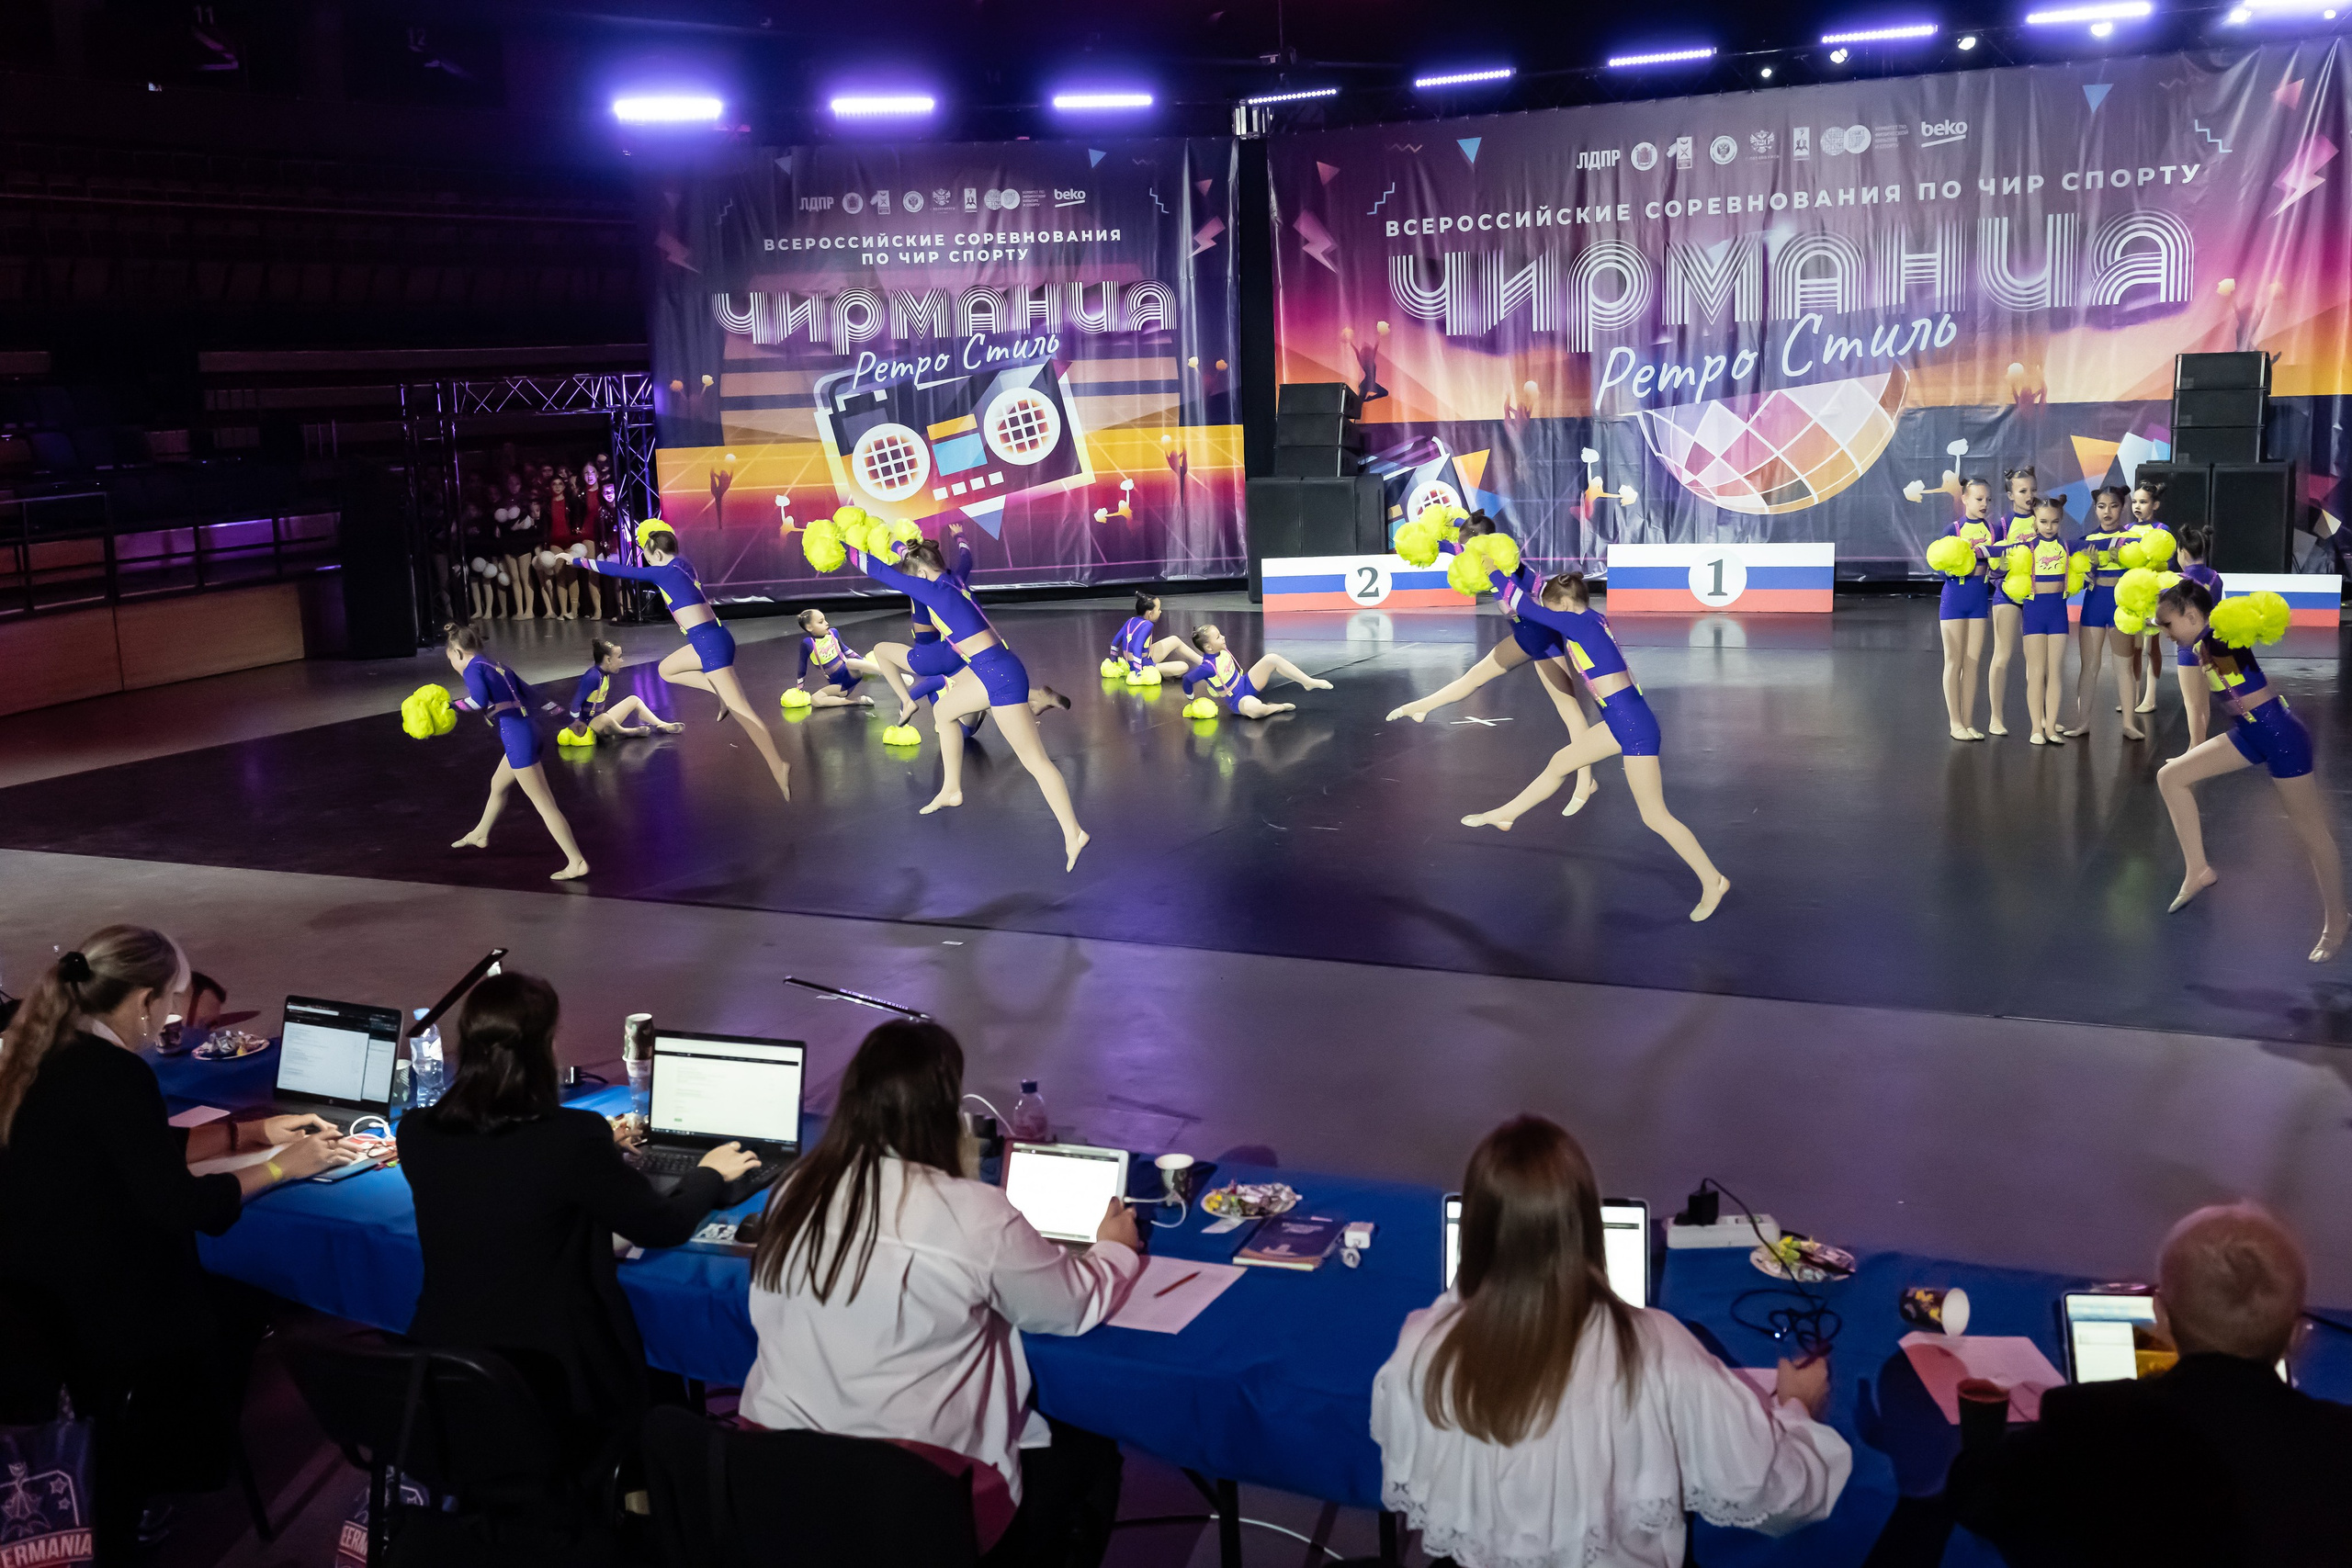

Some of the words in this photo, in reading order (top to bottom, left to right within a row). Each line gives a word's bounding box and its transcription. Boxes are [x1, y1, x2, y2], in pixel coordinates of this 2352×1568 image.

[1920, 118, 1968, 137] beko
[1576, 149, 1621, 172] ЛДПР
[799, 196, 834, 212] ЛДПР
[1054, 188, 1087, 200] beko
[1385, 203, 1632, 238] ВСЕРОССИЙСКИЕ
[1645, 183, 1902, 220] СОРЕВНОВАНИЯ
[1918, 180, 1962, 201] ПО
[1978, 174, 2045, 197] ЧИР
[2062, 164, 2203, 192] СПОРТУ
[763, 233, 945, 252] ВСЕРОССИЙСКИЕ
[954, 228, 1123, 246] СОРЕВНОВАНИЯ
[862, 252, 889, 265] ПО
[899, 251, 940, 264] ЧИР
[948, 247, 1029, 263] СПОРТУ
[853, 351, 970, 390] Ретро
[963, 333, 1061, 366] Стиль
[1595, 339, 1758, 411] Ретро
[1781, 311, 1959, 378] Стиль
[1356, 566, 1380, 598] 2
[1706, 558, 1728, 597] 1
